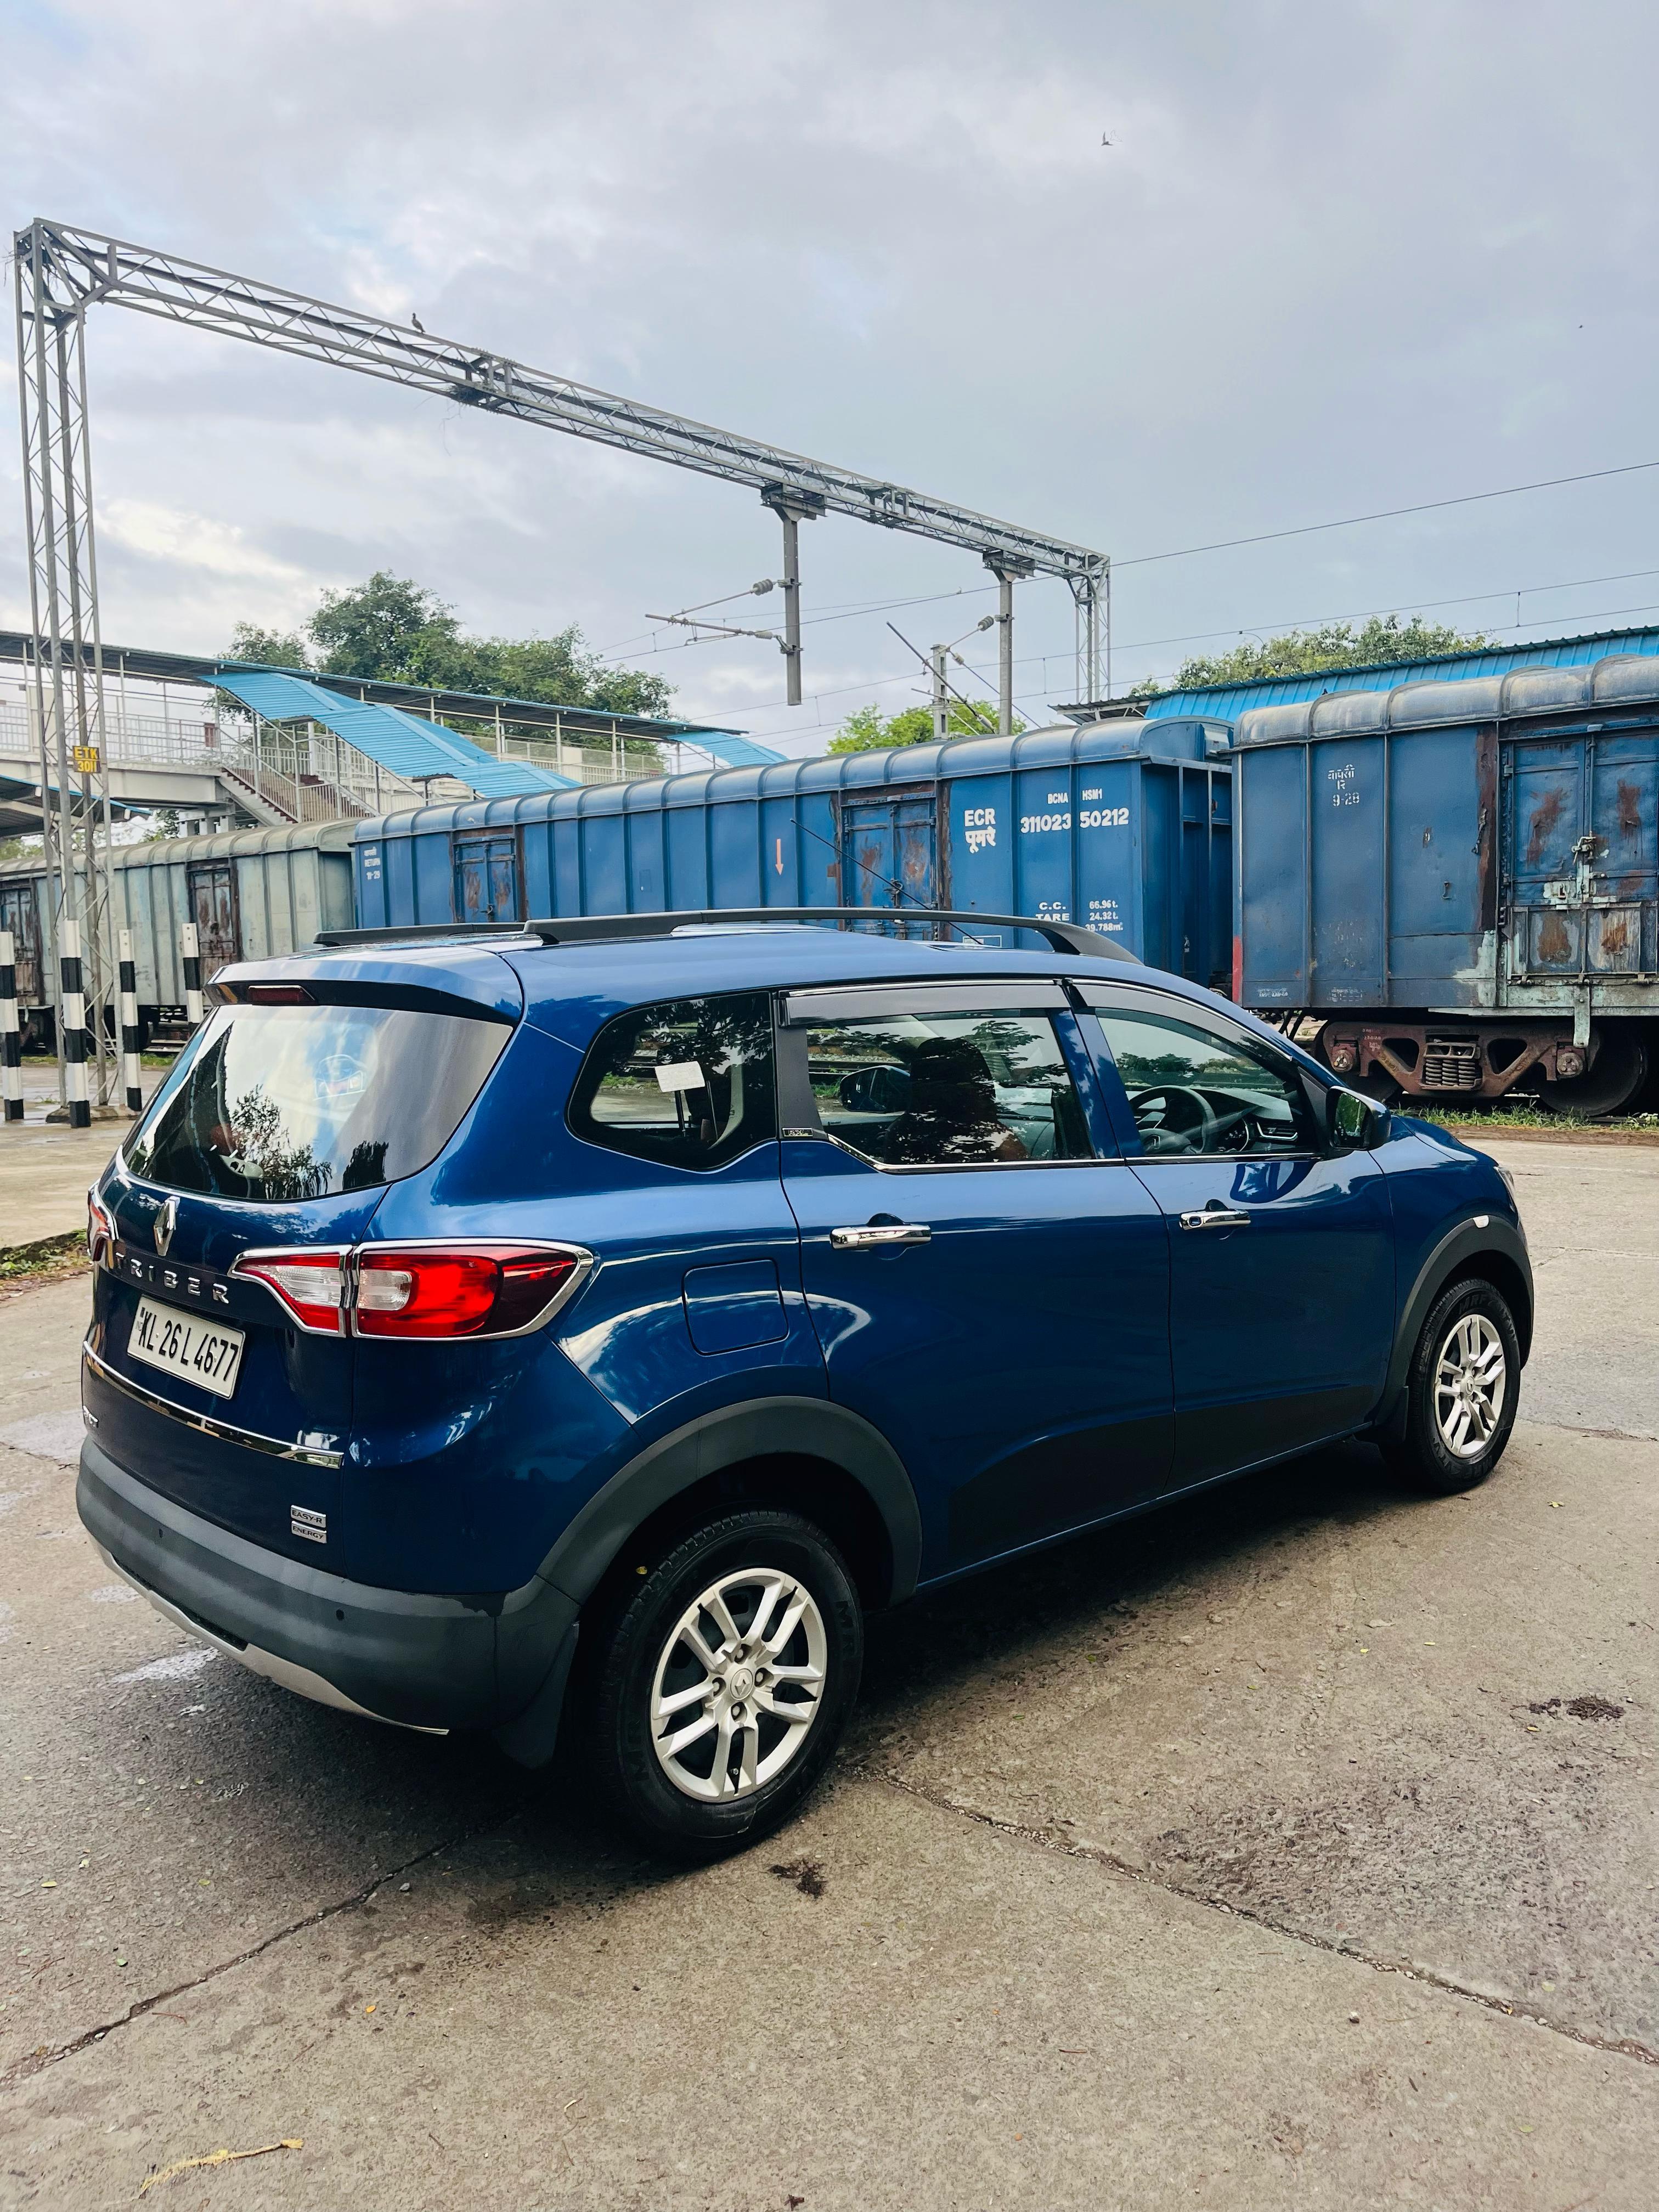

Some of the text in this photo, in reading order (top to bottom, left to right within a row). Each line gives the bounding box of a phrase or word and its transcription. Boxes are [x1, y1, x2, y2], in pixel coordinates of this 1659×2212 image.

[74, 747, 98, 759] ETK
[77, 760, 97, 772] 3011
[1328, 764, 1355, 780] वापसी
[1337, 779, 1345, 790] R
[1047, 788, 1102, 804] BCNA HSM1
[1333, 792, 1359, 806] 9-28
[964, 808, 996, 827] ECR
[1020, 808, 1129, 833] 311023 50212
[1039, 901, 1066, 910] C.C.
[1035, 913, 1069, 922] TARE
[115, 1252, 229, 1304] TRIBER
[138, 1311, 239, 1382] KL 26 L 4677
[292, 1510, 323, 1524] EASY-R
[292, 1526, 324, 1539] ENERGY
